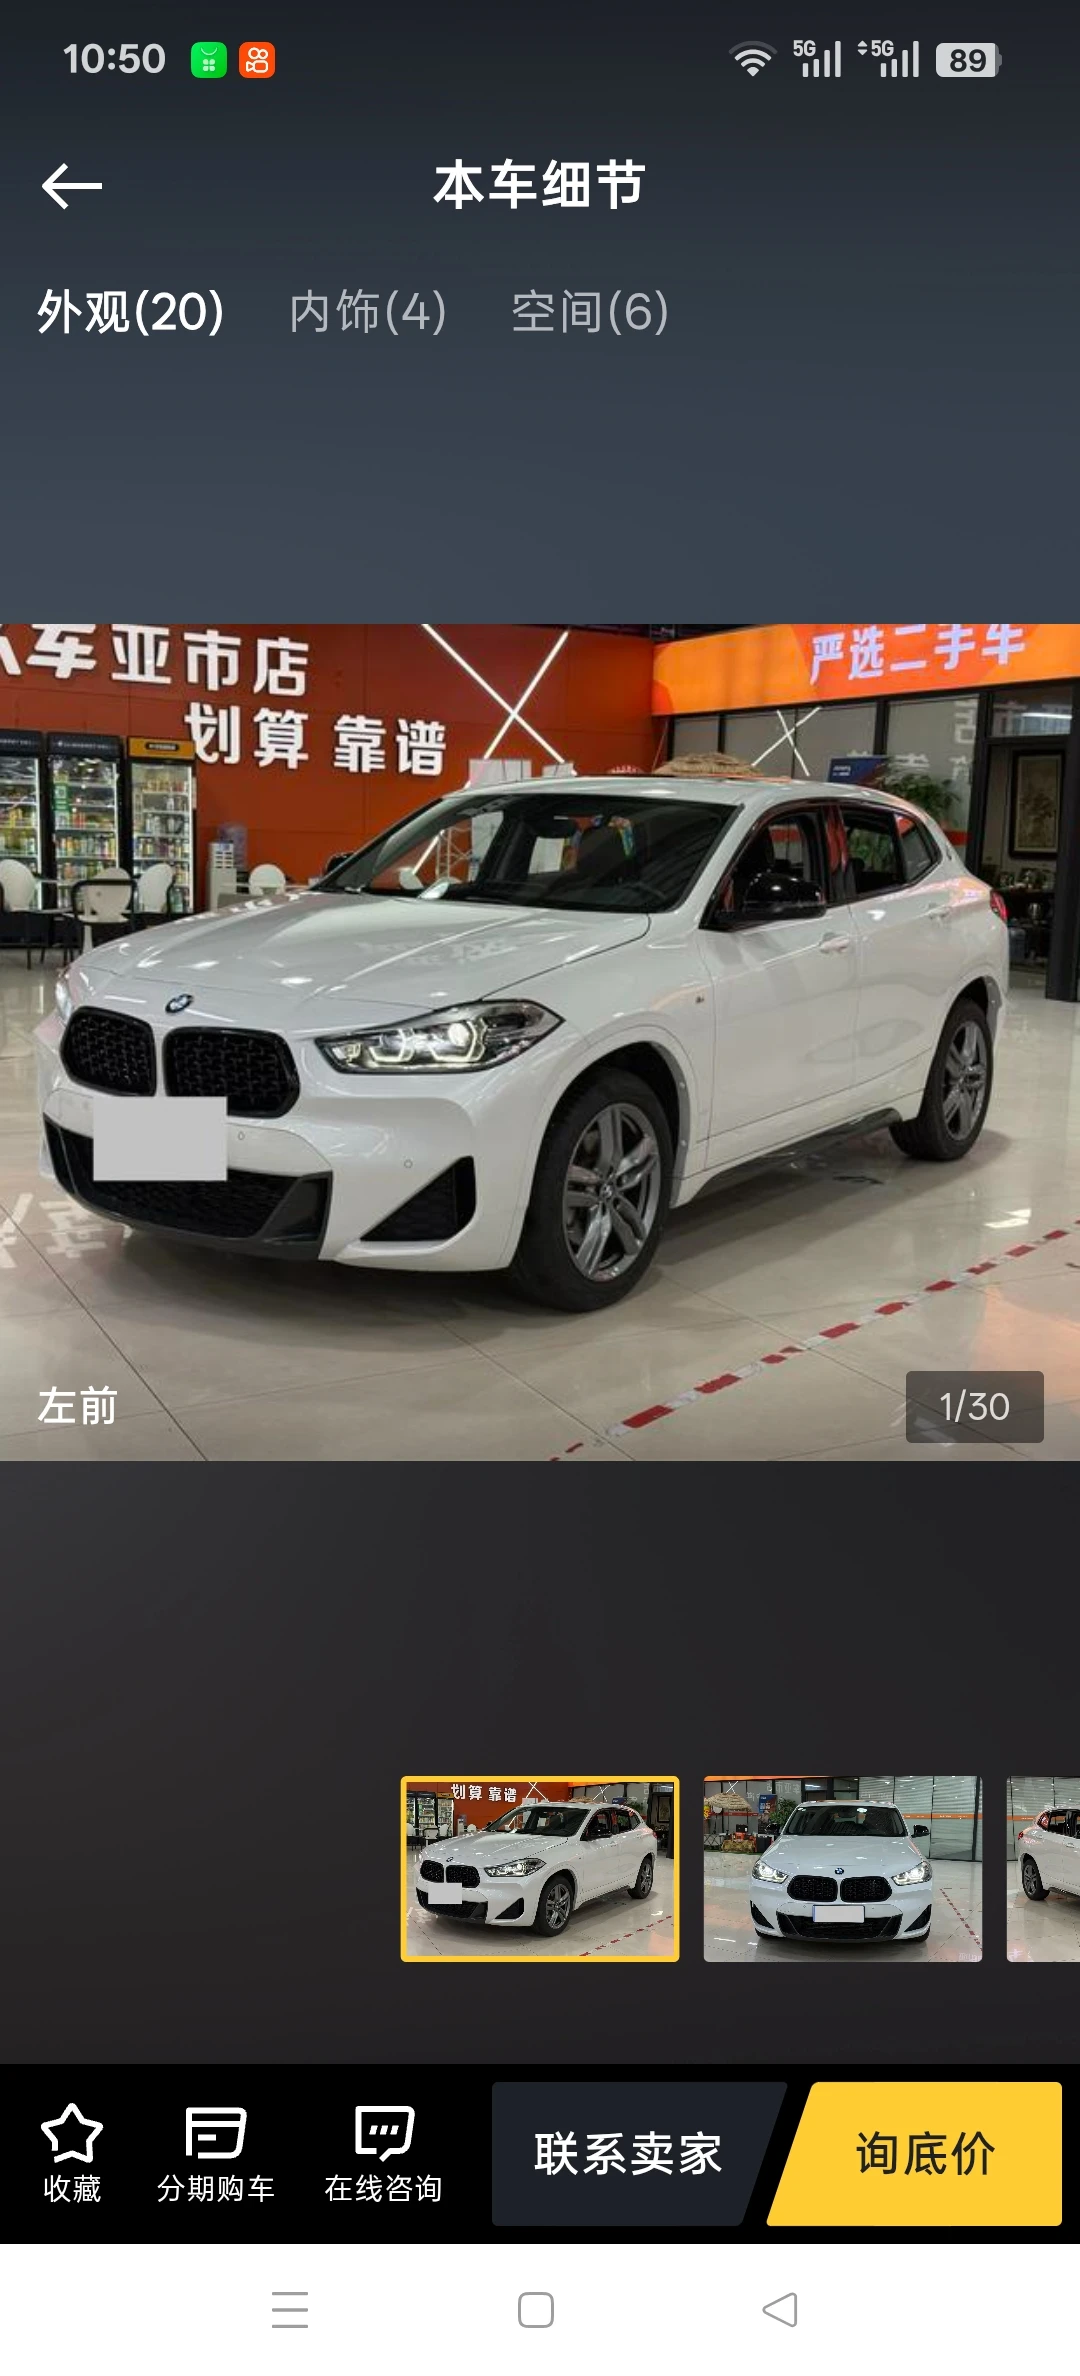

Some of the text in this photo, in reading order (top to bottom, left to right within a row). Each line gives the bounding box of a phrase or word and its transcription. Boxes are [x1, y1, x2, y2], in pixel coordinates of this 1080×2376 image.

[63, 43, 166, 74] 10:50
[792, 39, 817, 57] 5G
[870, 39, 895, 57] 5G
[949, 48, 987, 73] 89
[432, 158, 646, 210] 本车细节
[36, 288, 223, 337] 外观(20)
[290, 288, 446, 336] 内饰(4)
[512, 288, 668, 336] 空间(6)
[810, 625, 1027, 686] 严选二手车
[185, 703, 446, 776] 划算 靠谱
[450, 1783, 517, 1803] 划算 靠谱
[534, 2130, 723, 2176] 联系卖家
[856, 2130, 996, 2176] 询底价
[42, 2173, 102, 2204] 收藏
[157, 2173, 275, 2204] 分期购车
[324, 2173, 442, 2204] 在线咨询
